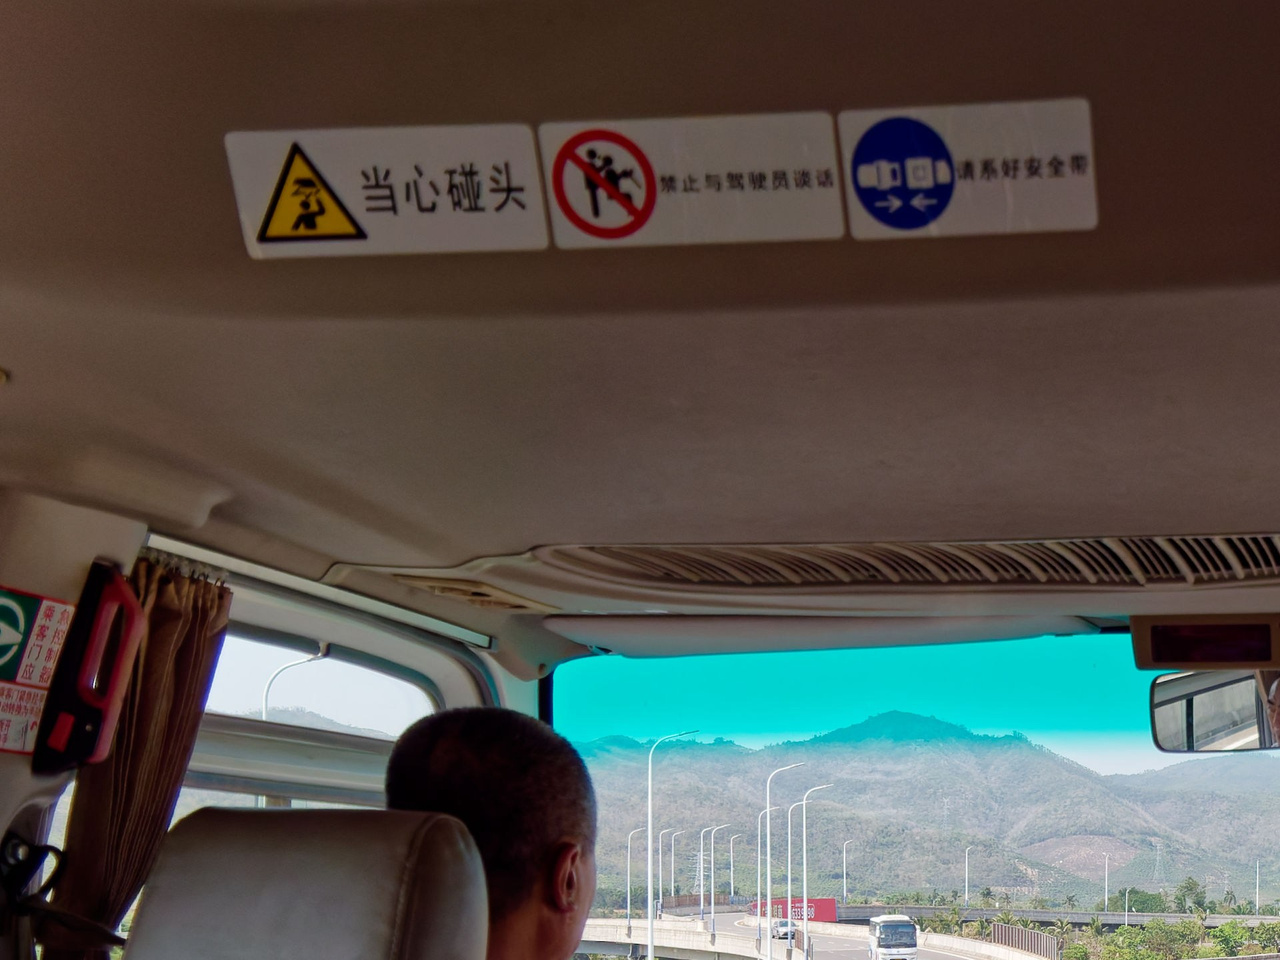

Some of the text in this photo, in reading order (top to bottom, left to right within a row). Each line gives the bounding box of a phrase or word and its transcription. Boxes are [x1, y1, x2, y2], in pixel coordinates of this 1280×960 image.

[660, 168, 834, 194] 禁止与驾驶员谈话
[956, 154, 1089, 181] 请系好安全带
[360, 162, 528, 217] 当心碰头
